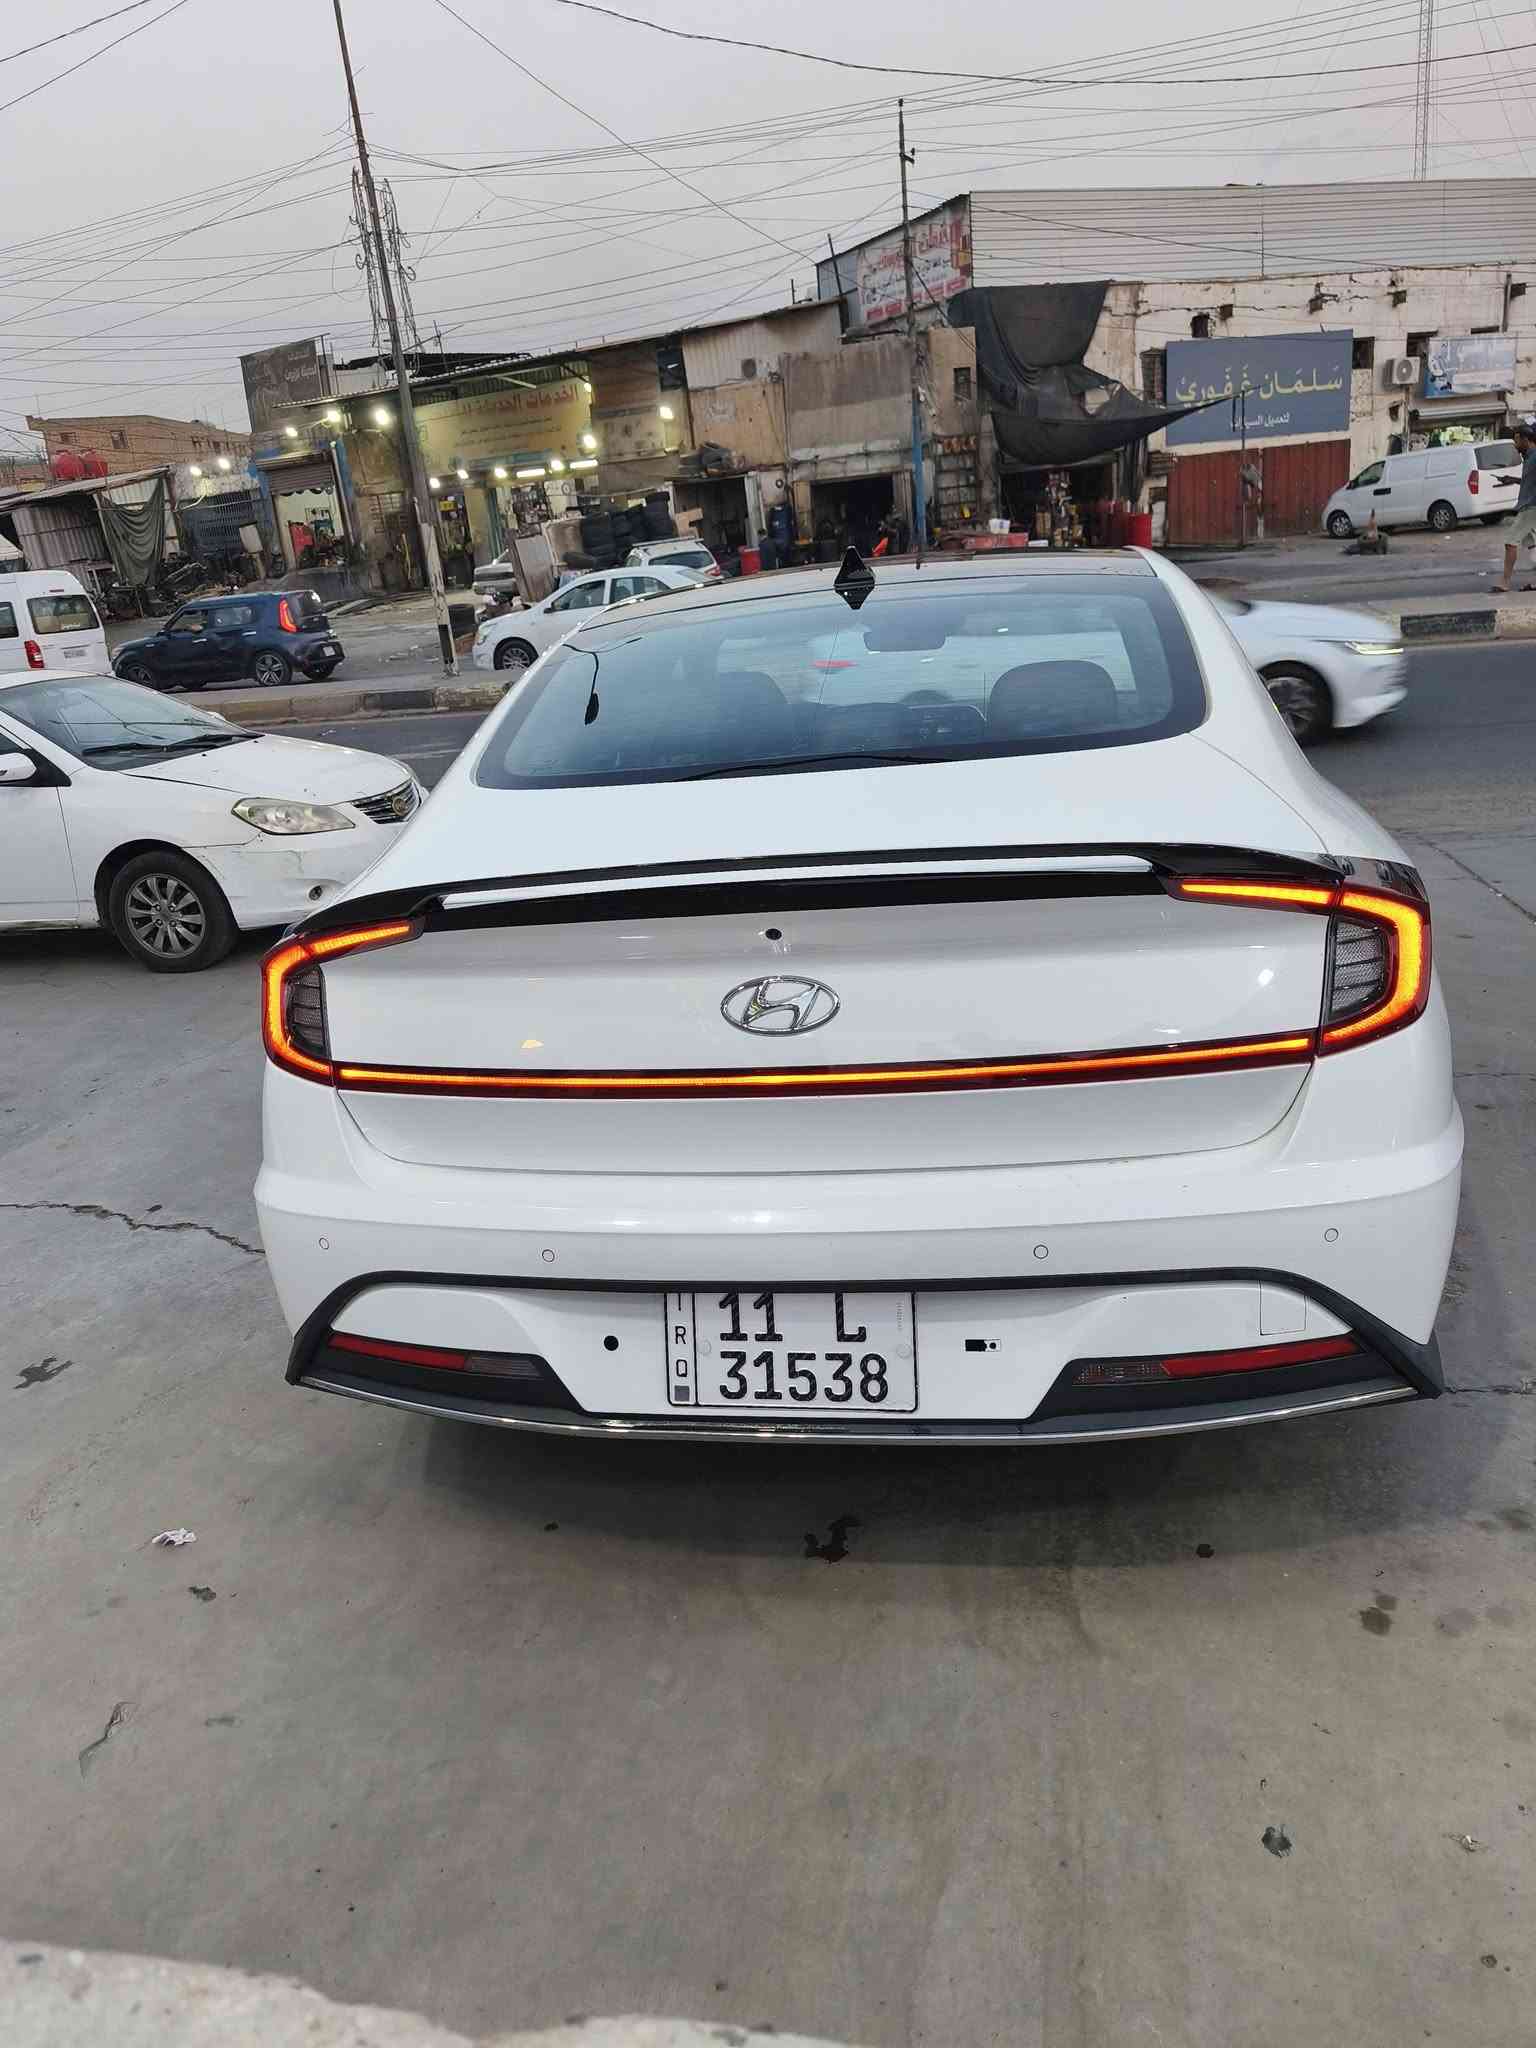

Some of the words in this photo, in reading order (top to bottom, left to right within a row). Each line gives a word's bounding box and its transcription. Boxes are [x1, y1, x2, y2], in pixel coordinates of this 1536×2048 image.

[718, 1291, 784, 1342] 11
[834, 1291, 867, 1343] L
[719, 1350, 889, 1403] 31538
